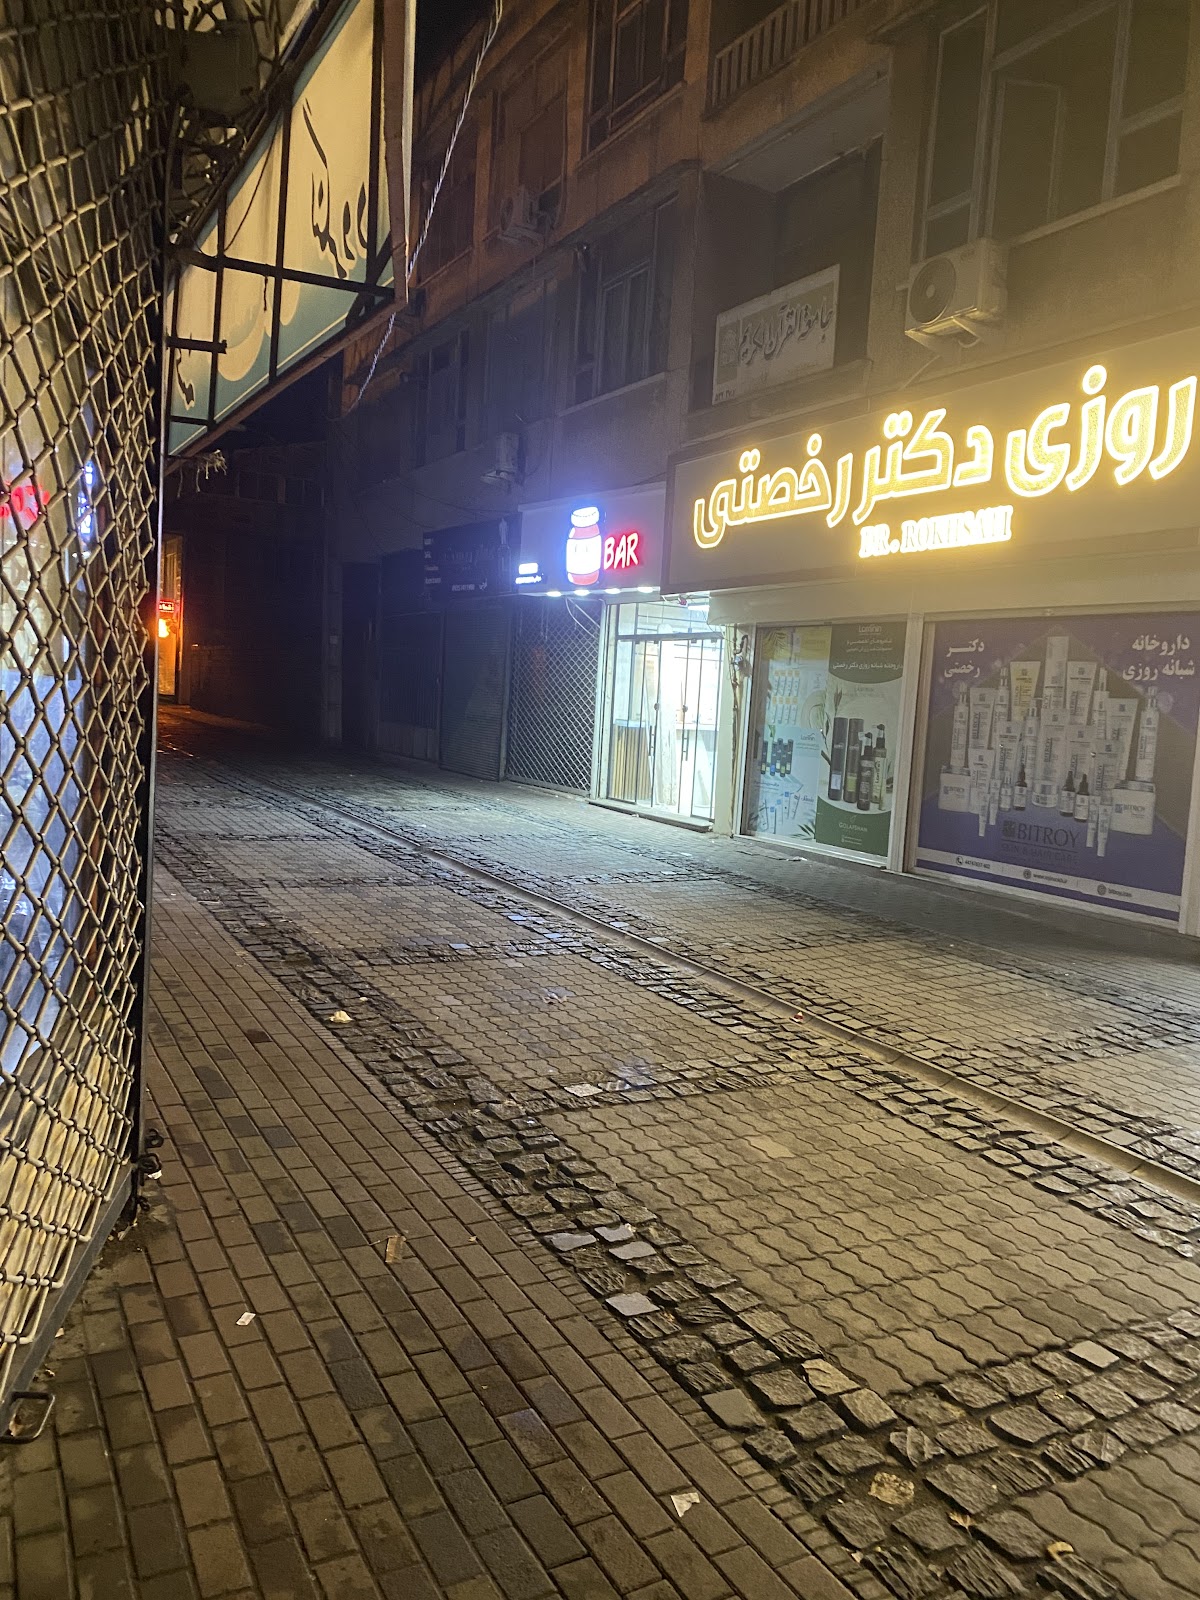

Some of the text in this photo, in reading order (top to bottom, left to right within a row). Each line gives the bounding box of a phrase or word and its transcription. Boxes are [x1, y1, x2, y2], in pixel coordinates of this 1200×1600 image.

[693, 364, 1198, 549] روزی دکتر رخصتی
[603, 532, 639, 571] BAR
[946, 638, 985, 657] دکتر
[1132, 634, 1190, 656] داروخانه
[944, 660, 980, 678] رخصتی
[1122, 659, 1195, 681] شبانه روزی
[1017, 823, 1081, 848] BITROY
